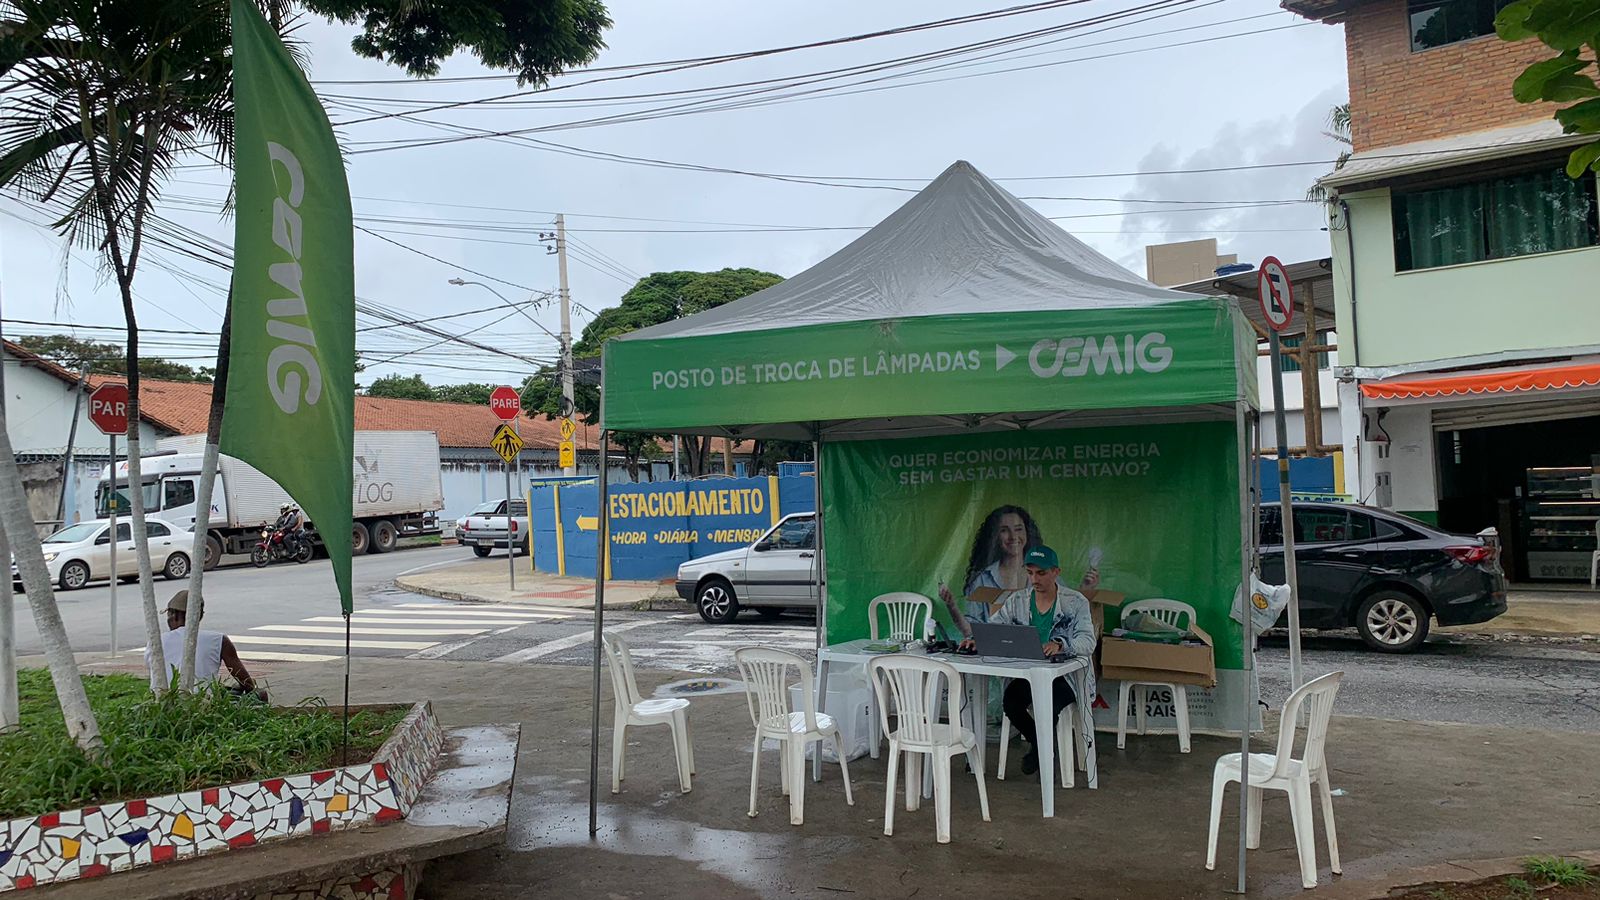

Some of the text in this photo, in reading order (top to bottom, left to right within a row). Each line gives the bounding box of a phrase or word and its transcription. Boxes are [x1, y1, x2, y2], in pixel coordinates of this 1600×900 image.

[652, 331, 1174, 390] POSTO DE TROCA DE LÂMPADAS CEMIG
[92, 400, 126, 417] PAR
[492, 398, 519, 409] PARE
[889, 442, 1160, 468] QUER ECONOMIZAR ENERGIA
[899, 460, 1151, 486] SEM GASTAR UM CENTAVO?
[609, 488, 764, 519] ESTACIONAMENTO
[616, 531, 647, 545] HORA
[1118, 689, 1171, 704] IAS
